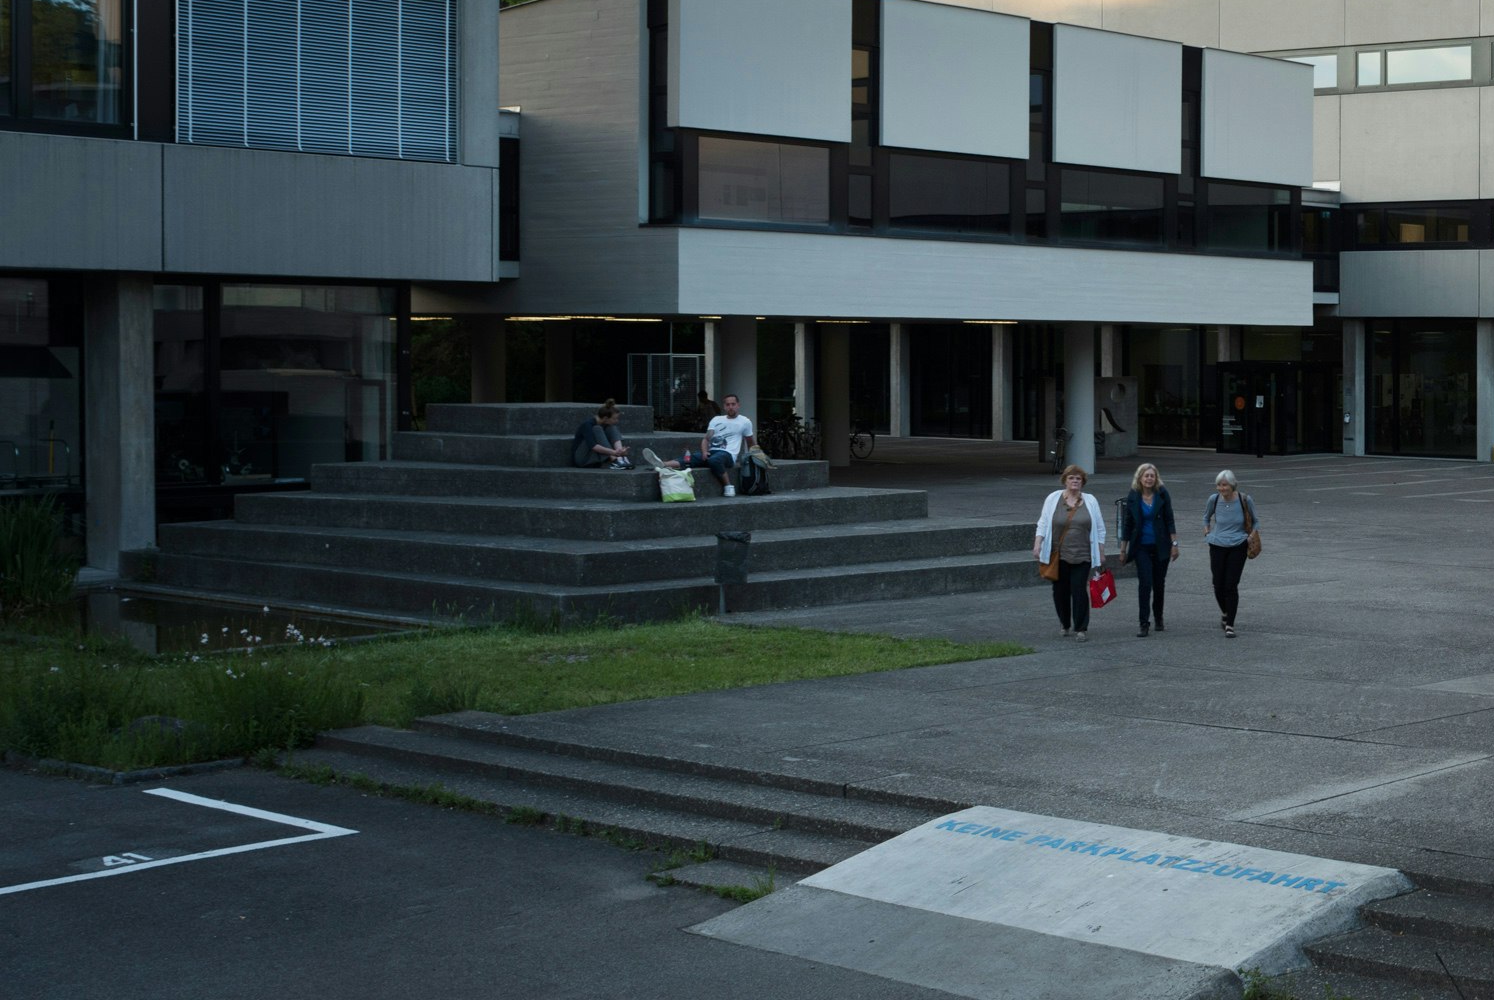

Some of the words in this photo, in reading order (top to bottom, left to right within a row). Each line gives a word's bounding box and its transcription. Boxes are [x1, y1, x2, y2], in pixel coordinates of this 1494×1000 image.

[102, 852, 154, 867] 41
[937, 819, 1023, 841] KEINE
[1026, 836, 1347, 894] PARKPLATZZUFAHRT
